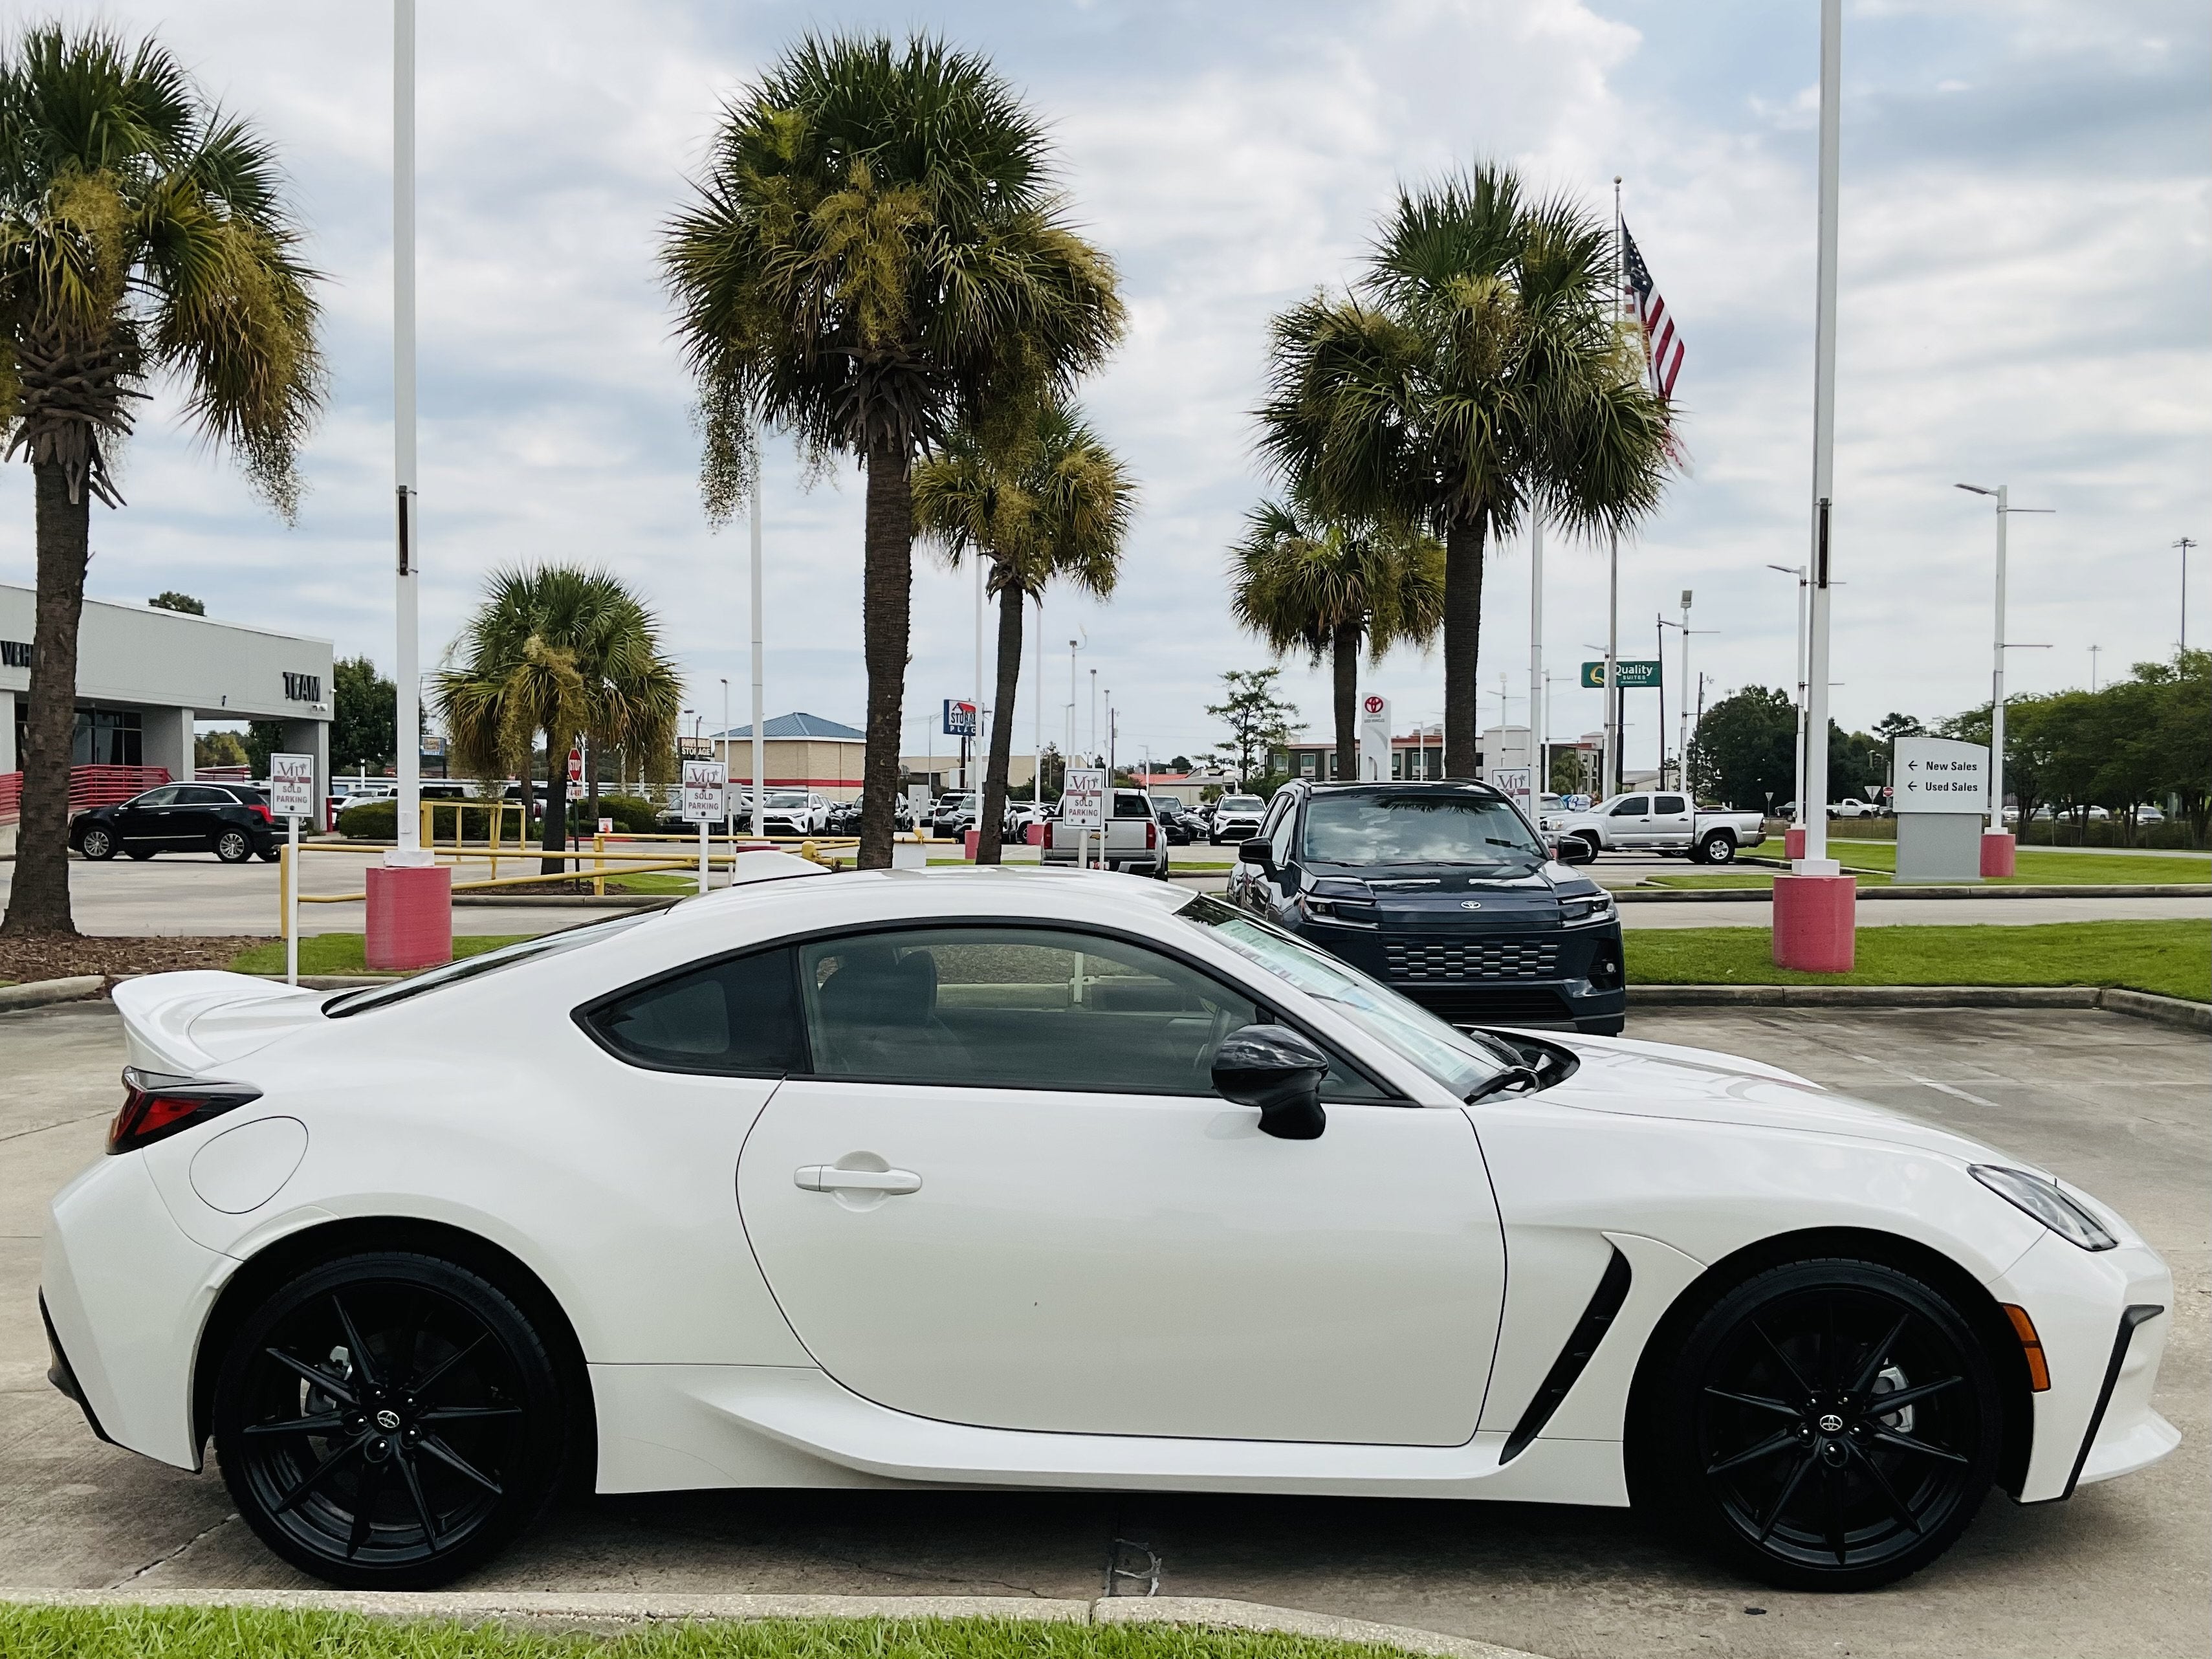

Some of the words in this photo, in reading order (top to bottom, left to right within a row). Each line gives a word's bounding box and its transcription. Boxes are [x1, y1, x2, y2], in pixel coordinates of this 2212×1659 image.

[1615, 665, 1653, 677] Quality
[283, 672, 320, 702] TEAM
[951, 711, 976, 724] STORA
[950, 725, 976, 734] PLAC
[569, 759, 581, 771] STOP
[1926, 761, 1948, 771] New
[1951, 761, 1977, 771] Sales
[282, 786, 301, 794] SOLD
[1925, 782, 1949, 791] Used
[1951, 782, 1978, 792] Sales
[276, 795, 308, 804] PARKING
